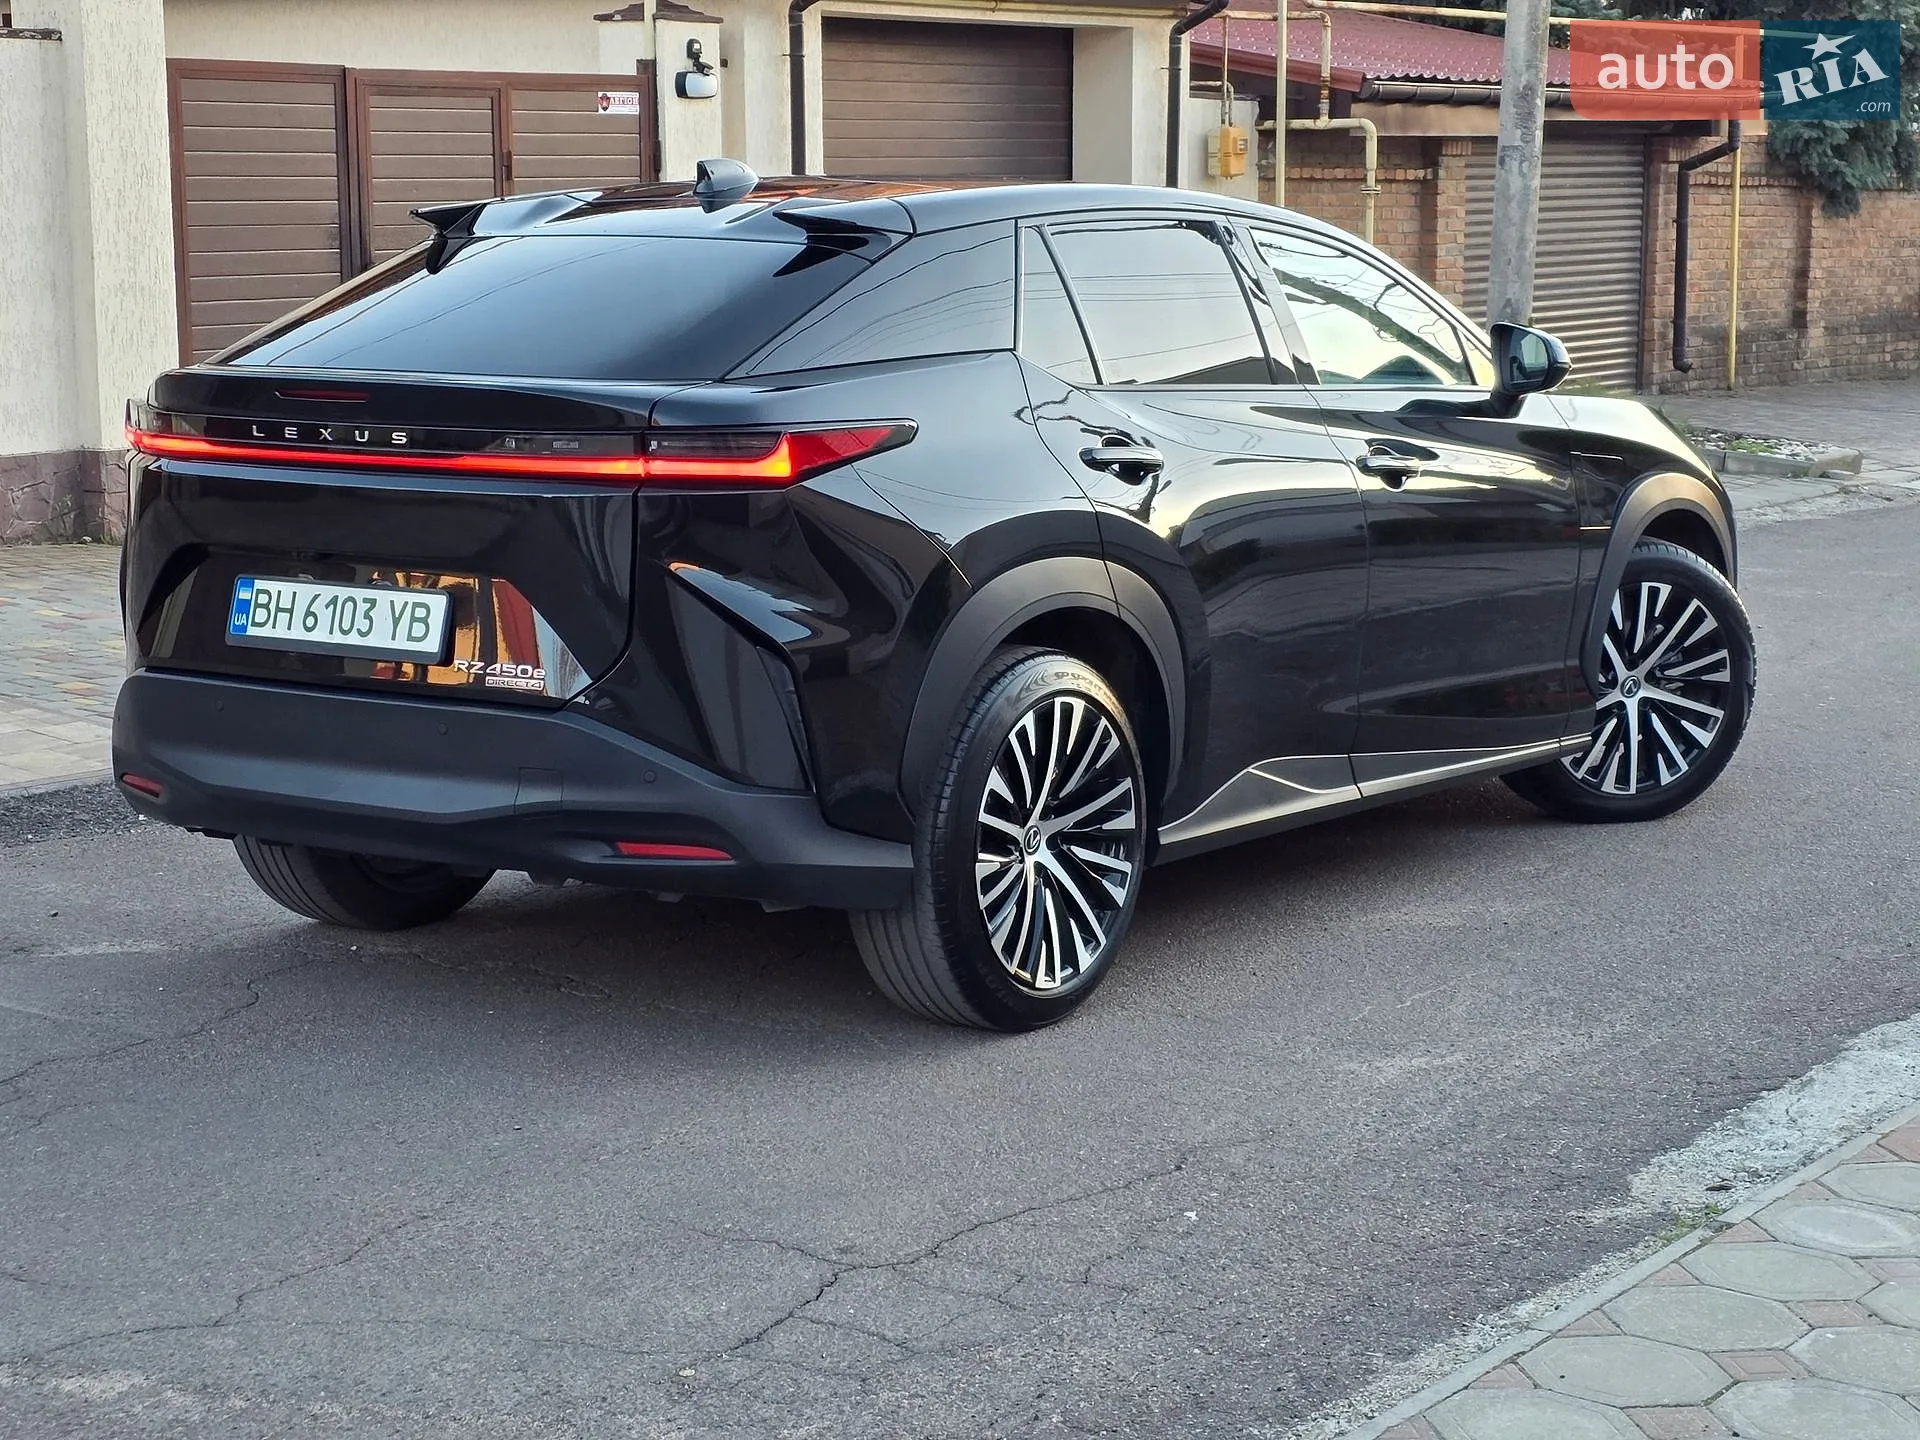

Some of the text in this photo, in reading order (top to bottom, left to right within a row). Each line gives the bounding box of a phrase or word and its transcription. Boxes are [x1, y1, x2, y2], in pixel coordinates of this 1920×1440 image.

[252, 425, 408, 444] LEXUS
[234, 613, 247, 626] UA
[250, 588, 431, 643] BH 6103 YB
[454, 660, 546, 679] RZ 450e
[486, 677, 543, 690] DIRECT4
